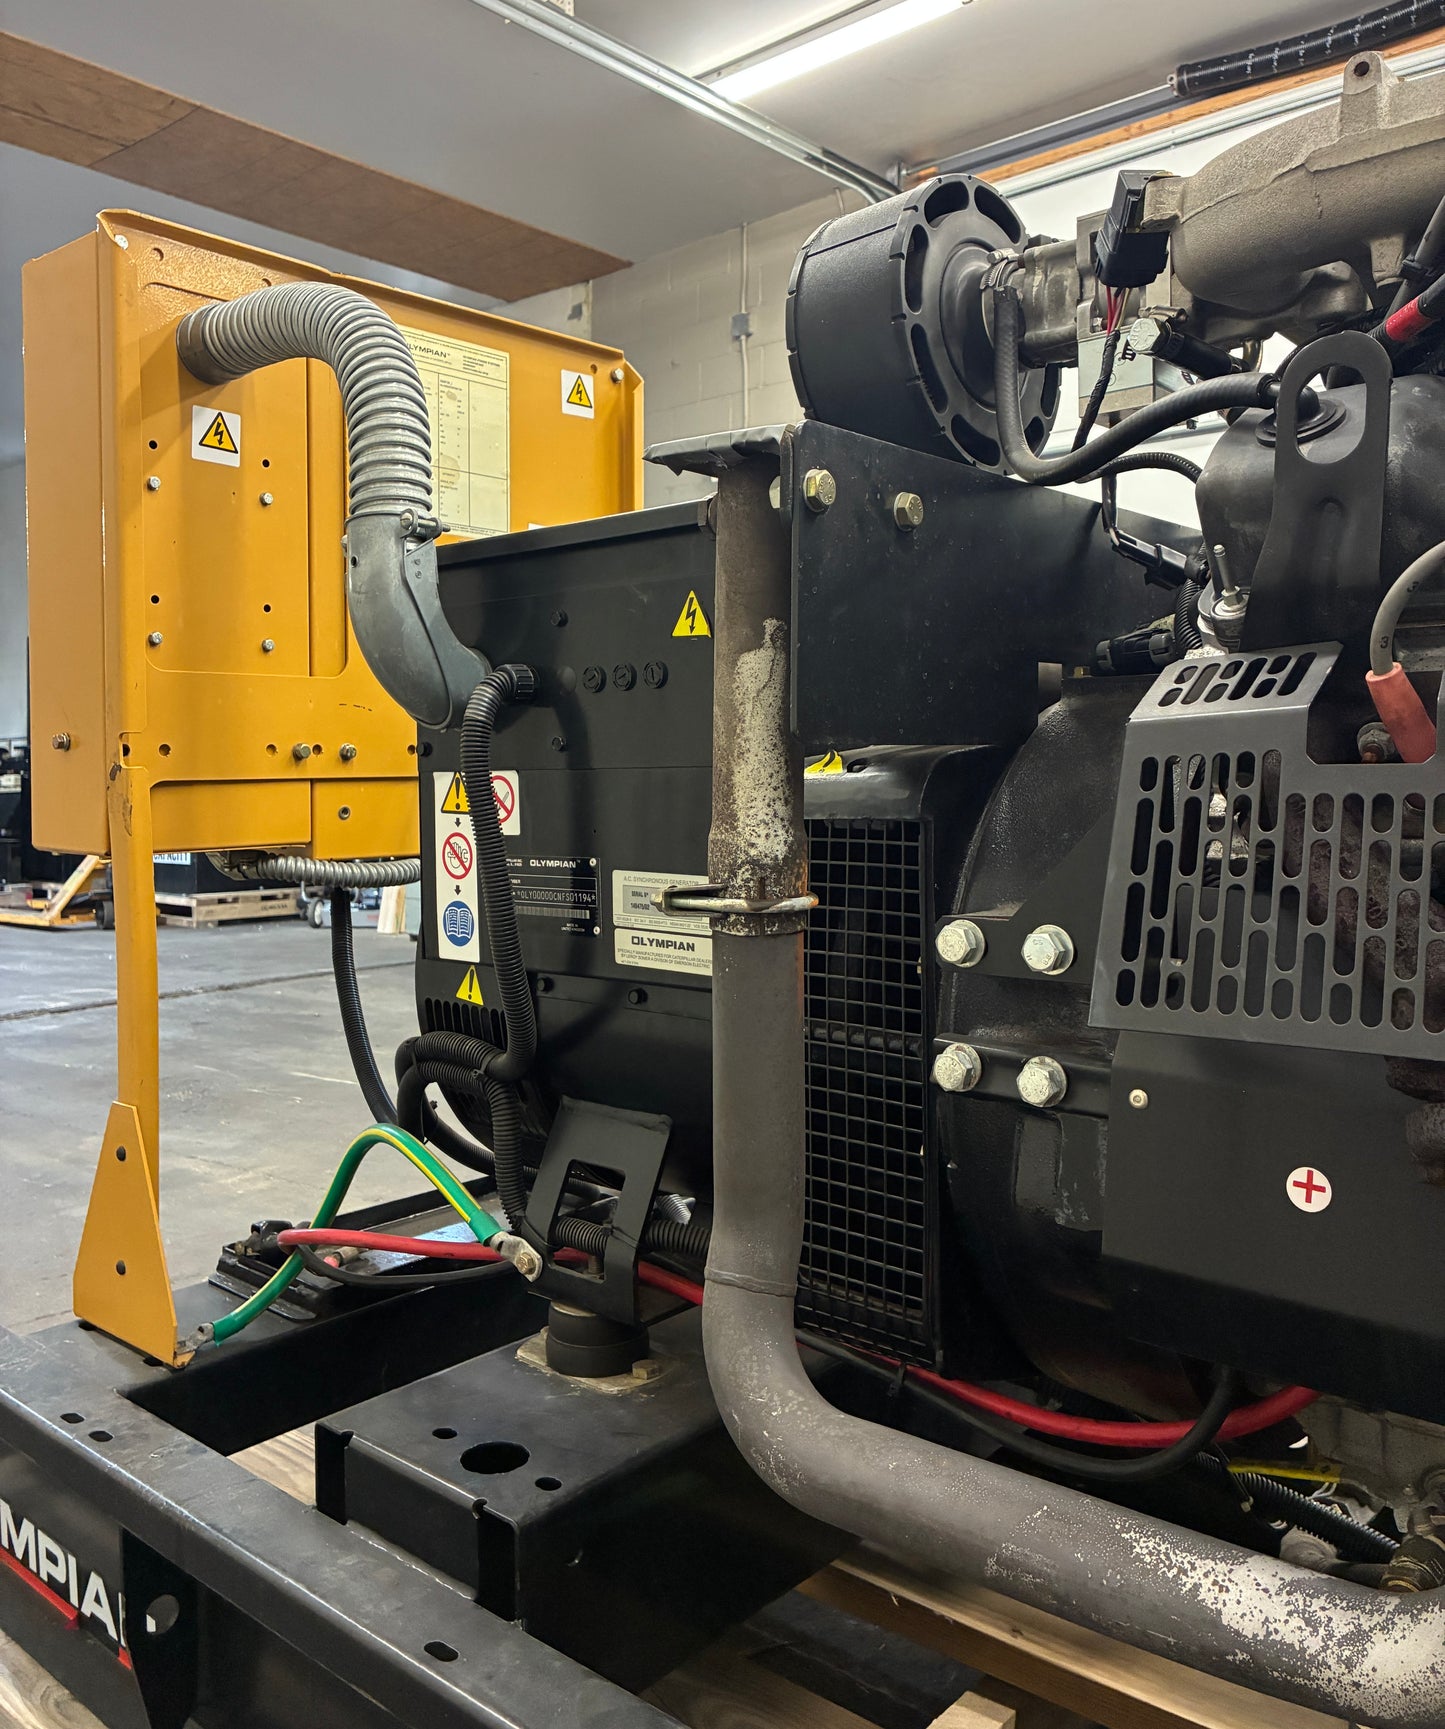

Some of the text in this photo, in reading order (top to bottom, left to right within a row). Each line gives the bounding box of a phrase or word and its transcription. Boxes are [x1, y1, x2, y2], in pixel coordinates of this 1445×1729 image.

[529, 859, 576, 868] OLYMPIAN
[631, 936, 695, 952] OLYMPIAN
[0, 1499, 127, 1649] MPIA
